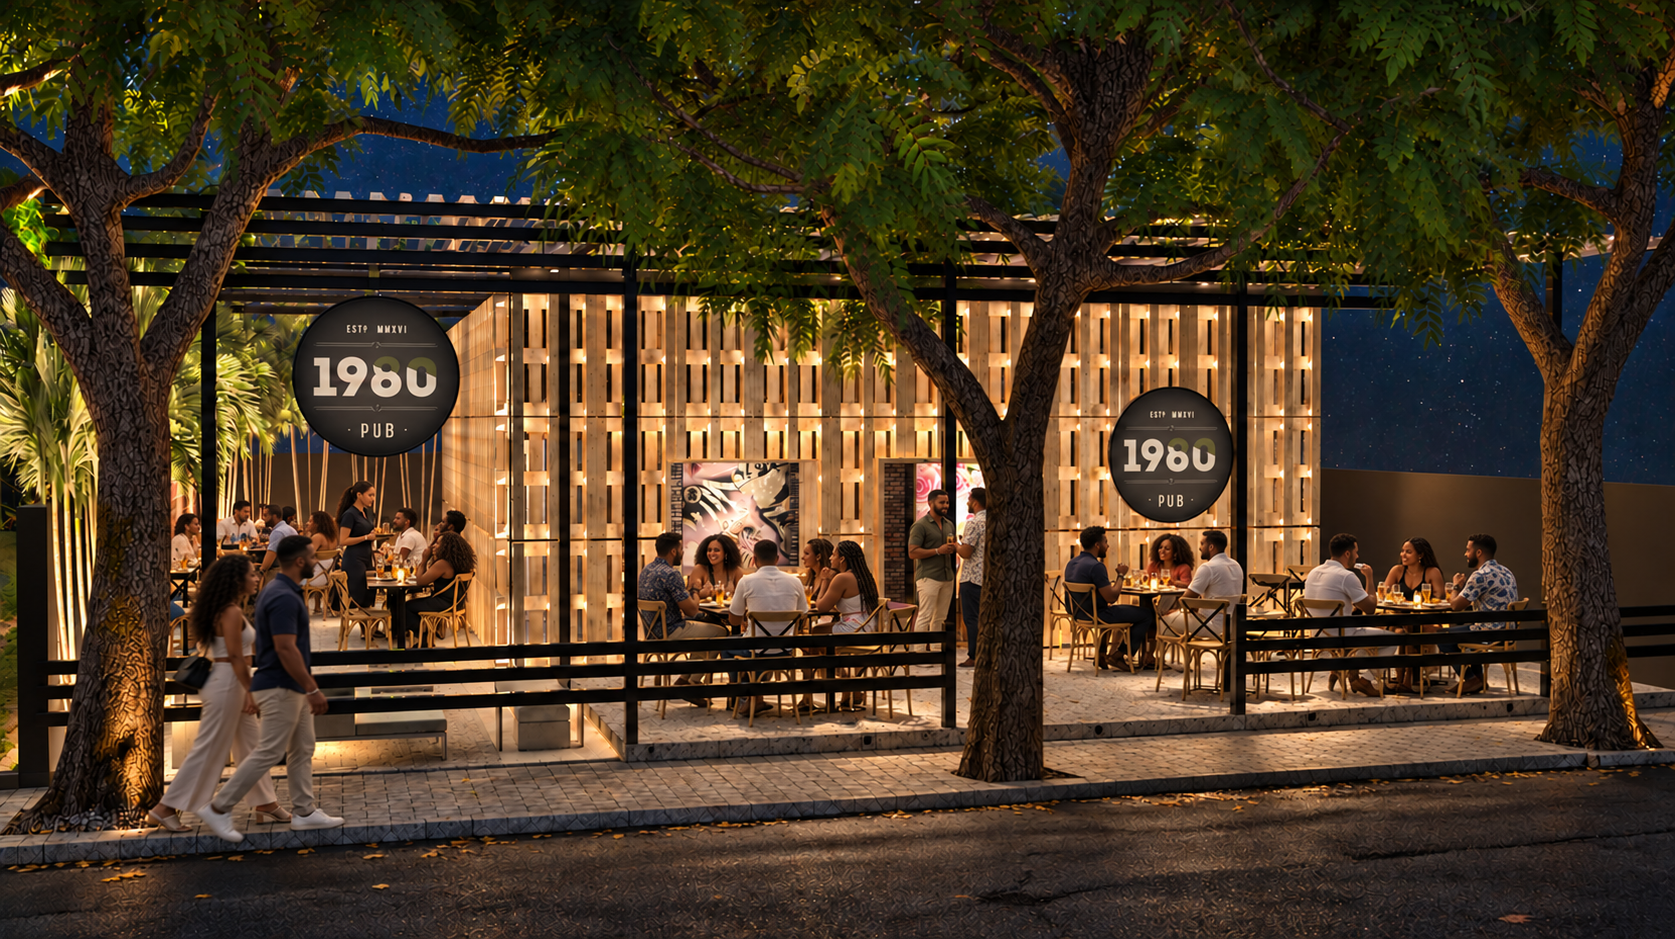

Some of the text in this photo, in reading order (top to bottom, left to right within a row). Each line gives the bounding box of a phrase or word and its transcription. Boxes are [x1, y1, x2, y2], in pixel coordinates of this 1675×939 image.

[377, 324, 407, 334] MMXVI
[313, 356, 437, 398] 1980
[360, 423, 395, 438] PUB
[1124, 437, 1216, 472] 1980
[1158, 494, 1184, 507] PUB
